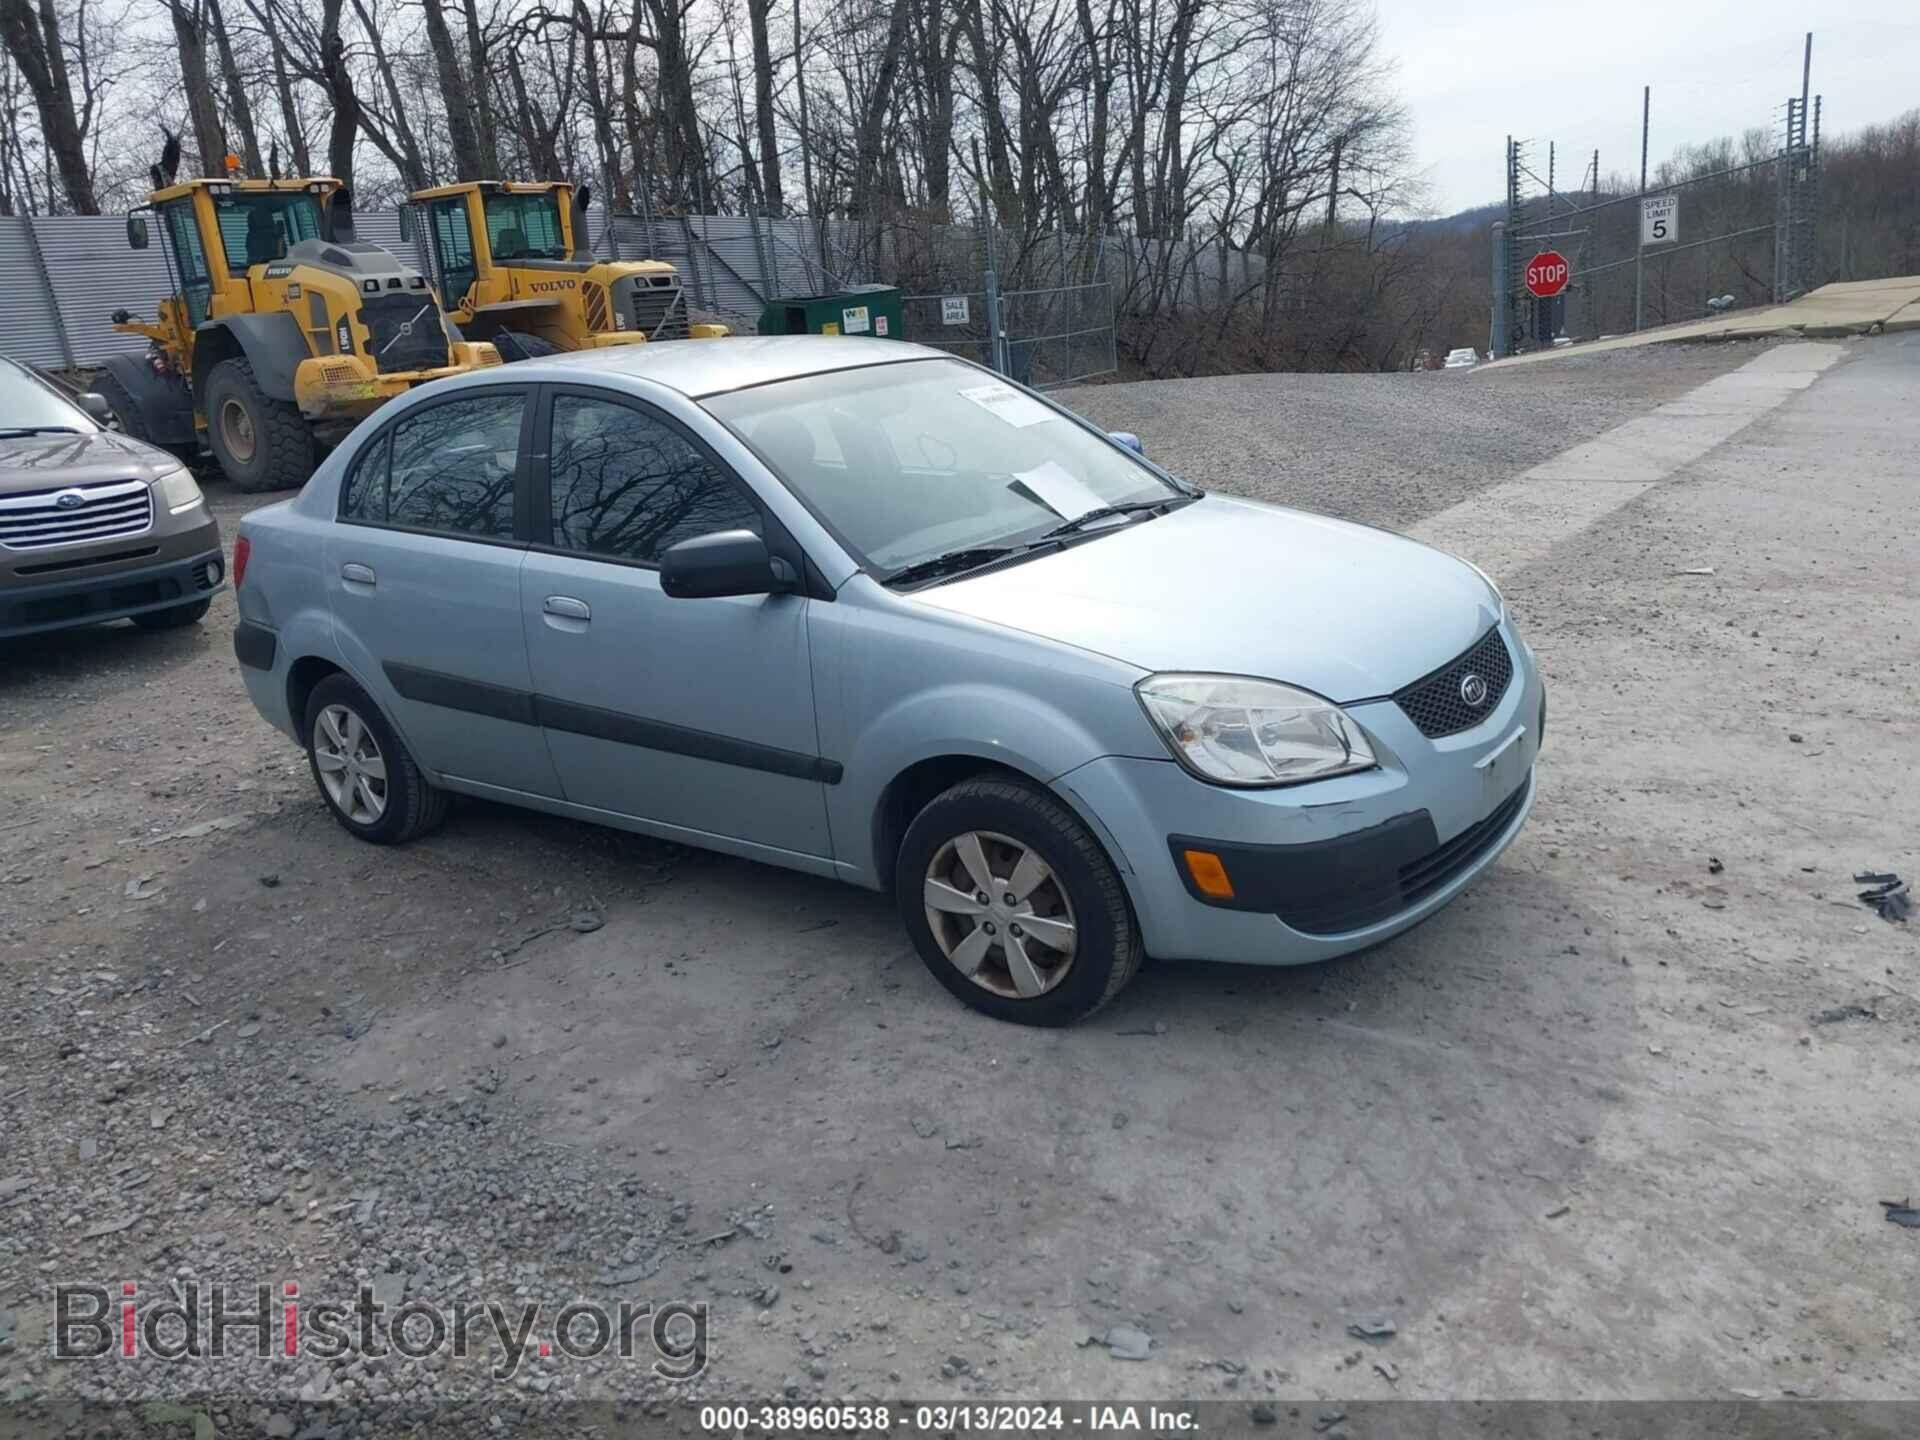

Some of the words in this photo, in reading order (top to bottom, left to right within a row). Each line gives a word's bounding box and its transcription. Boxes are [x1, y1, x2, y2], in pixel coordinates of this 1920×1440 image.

[1644, 199, 1675, 210] SPEED
[1647, 208, 1672, 219] LIMIT
[1652, 220, 1666, 239] 5
[1528, 264, 1566, 286] STOP
[529, 279, 577, 293] VOLVO
[944, 301, 964, 310] SALE
[945, 312, 966, 321] AREA
[1465, 679, 1482, 700] KIA
